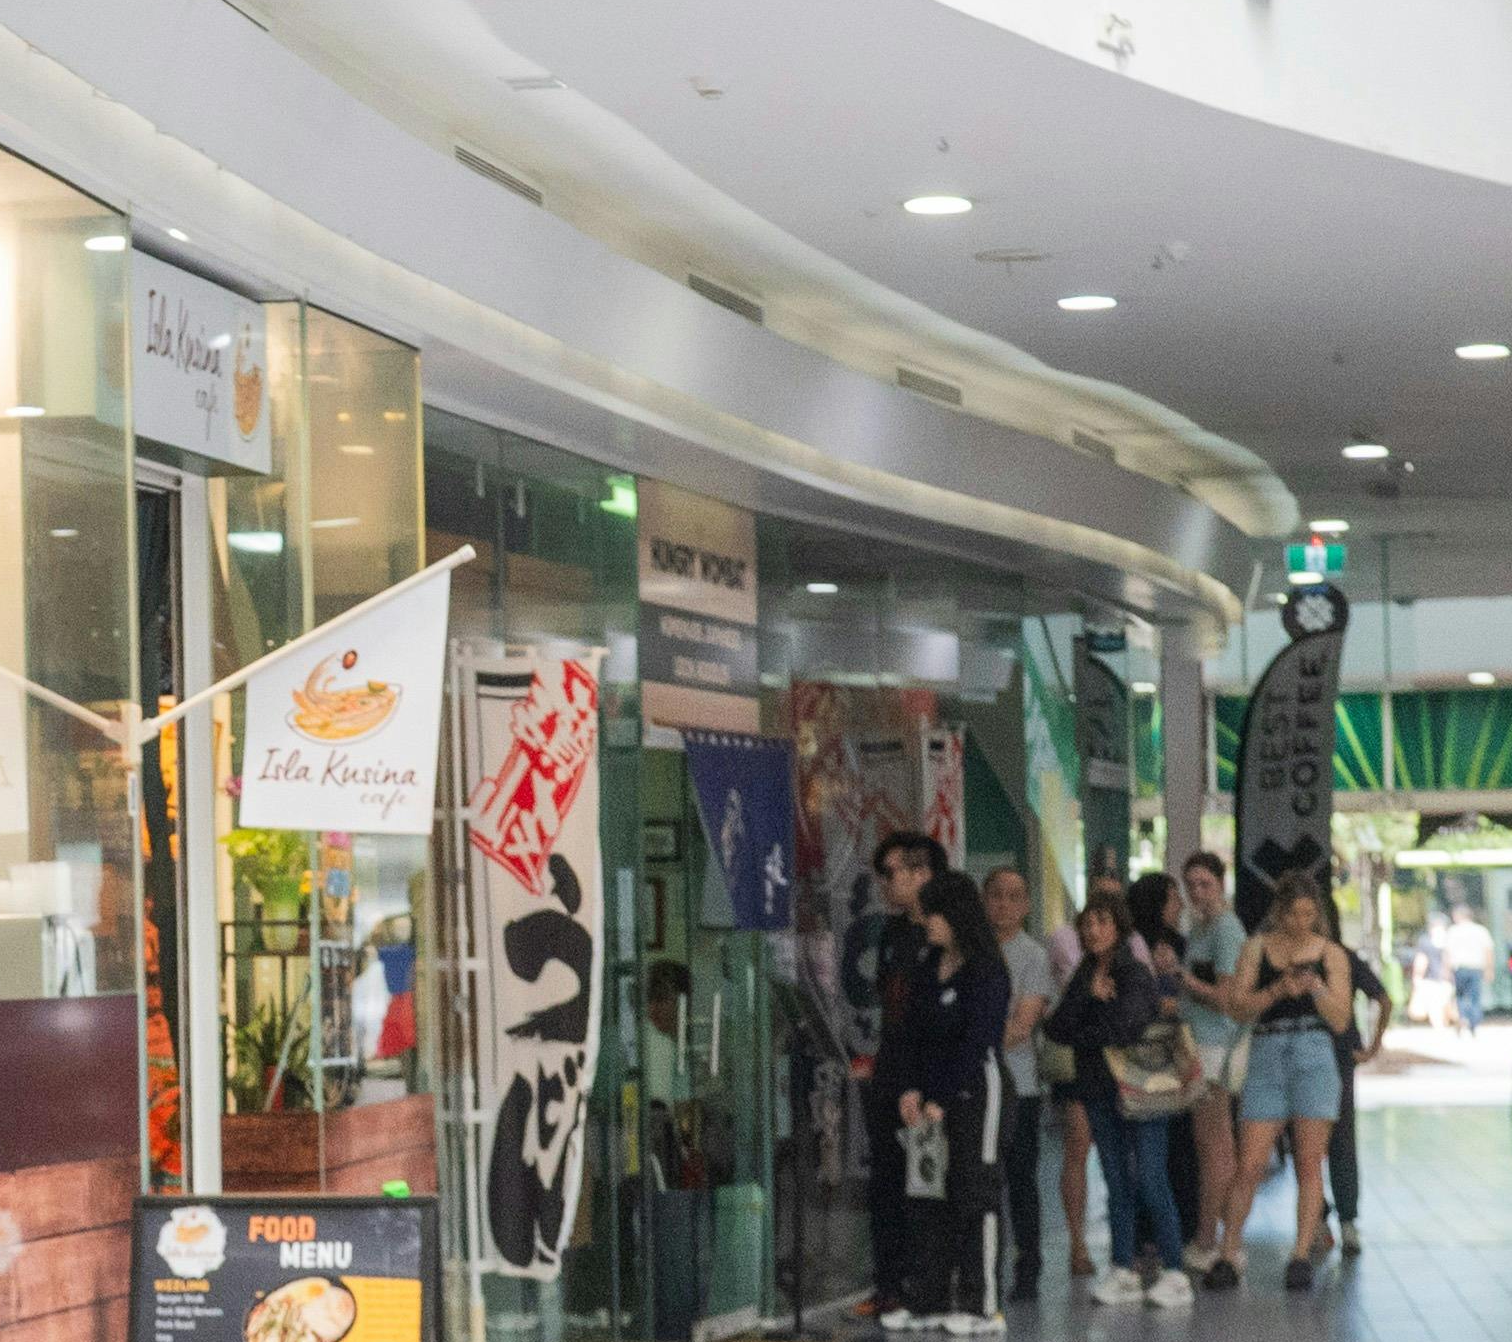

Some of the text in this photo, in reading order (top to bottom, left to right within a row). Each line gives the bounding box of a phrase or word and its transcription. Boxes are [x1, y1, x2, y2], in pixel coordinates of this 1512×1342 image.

[1292, 657, 1325, 816] COFFEE
[259, 747, 418, 788] Isla Kusina
[249, 1215, 316, 1242] FOOD
[280, 1241, 352, 1268] MENU
